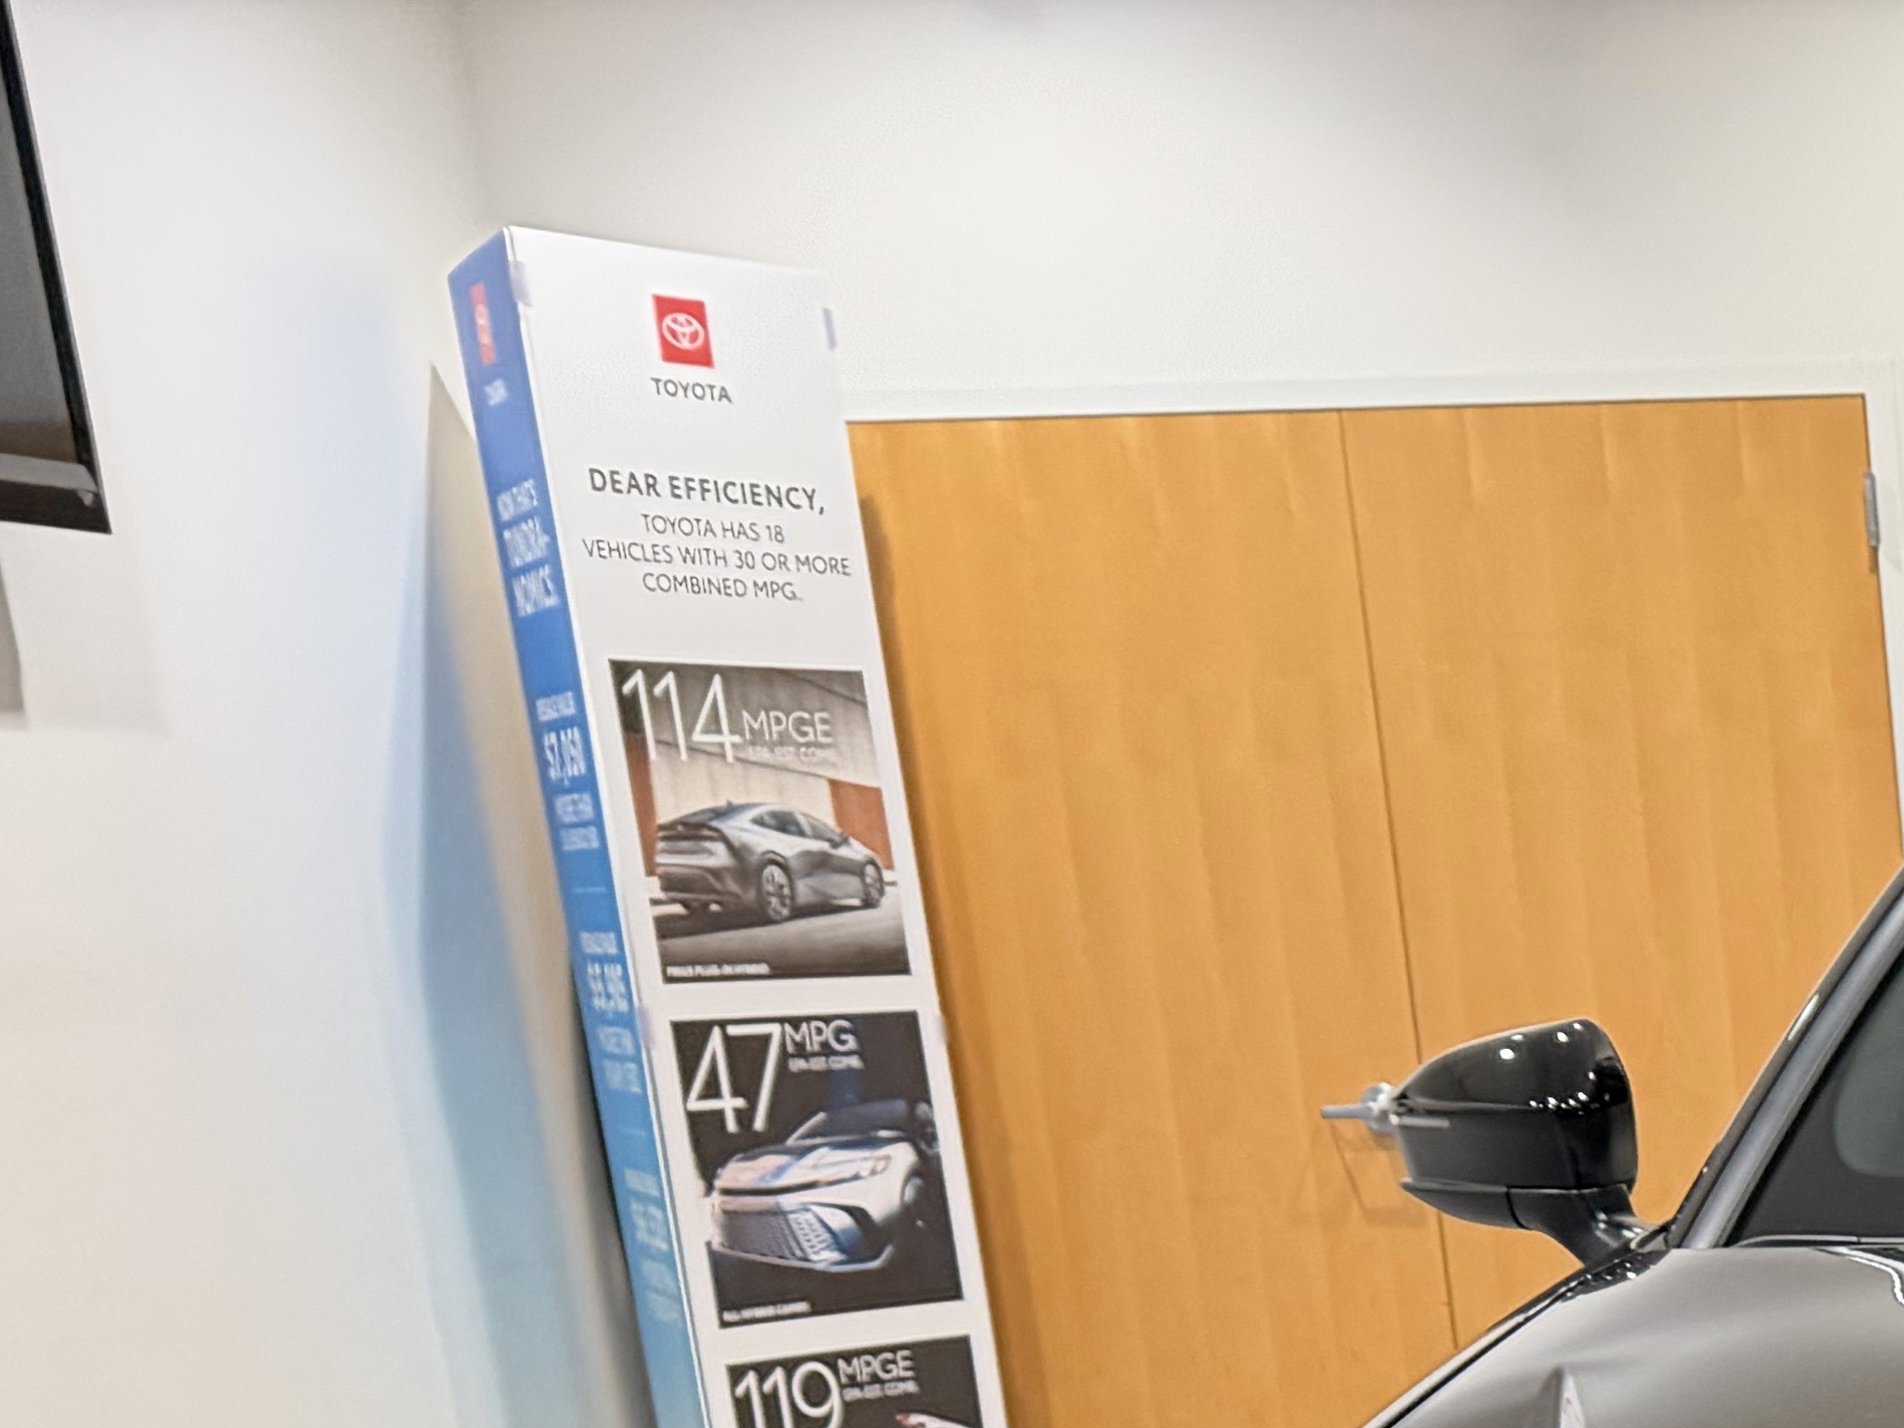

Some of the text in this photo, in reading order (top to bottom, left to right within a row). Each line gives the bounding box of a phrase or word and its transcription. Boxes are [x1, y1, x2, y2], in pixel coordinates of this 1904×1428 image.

[650, 377, 733, 404] TOYOTA
[588, 467, 825, 515] DEAR EFFICIENCY,
[641, 513, 785, 544] TOYOTA HAS 18
[582, 539, 852, 576] VEHICLES WITH 30 OR MORE
[642, 572, 803, 601] COMBINED MPG.
[622, 668, 742, 763] 114
[741, 710, 834, 744] MPGE
[686, 1024, 782, 1133] 47
[785, 1019, 859, 1053] MPG
[838, 1349, 916, 1384] MPGE
